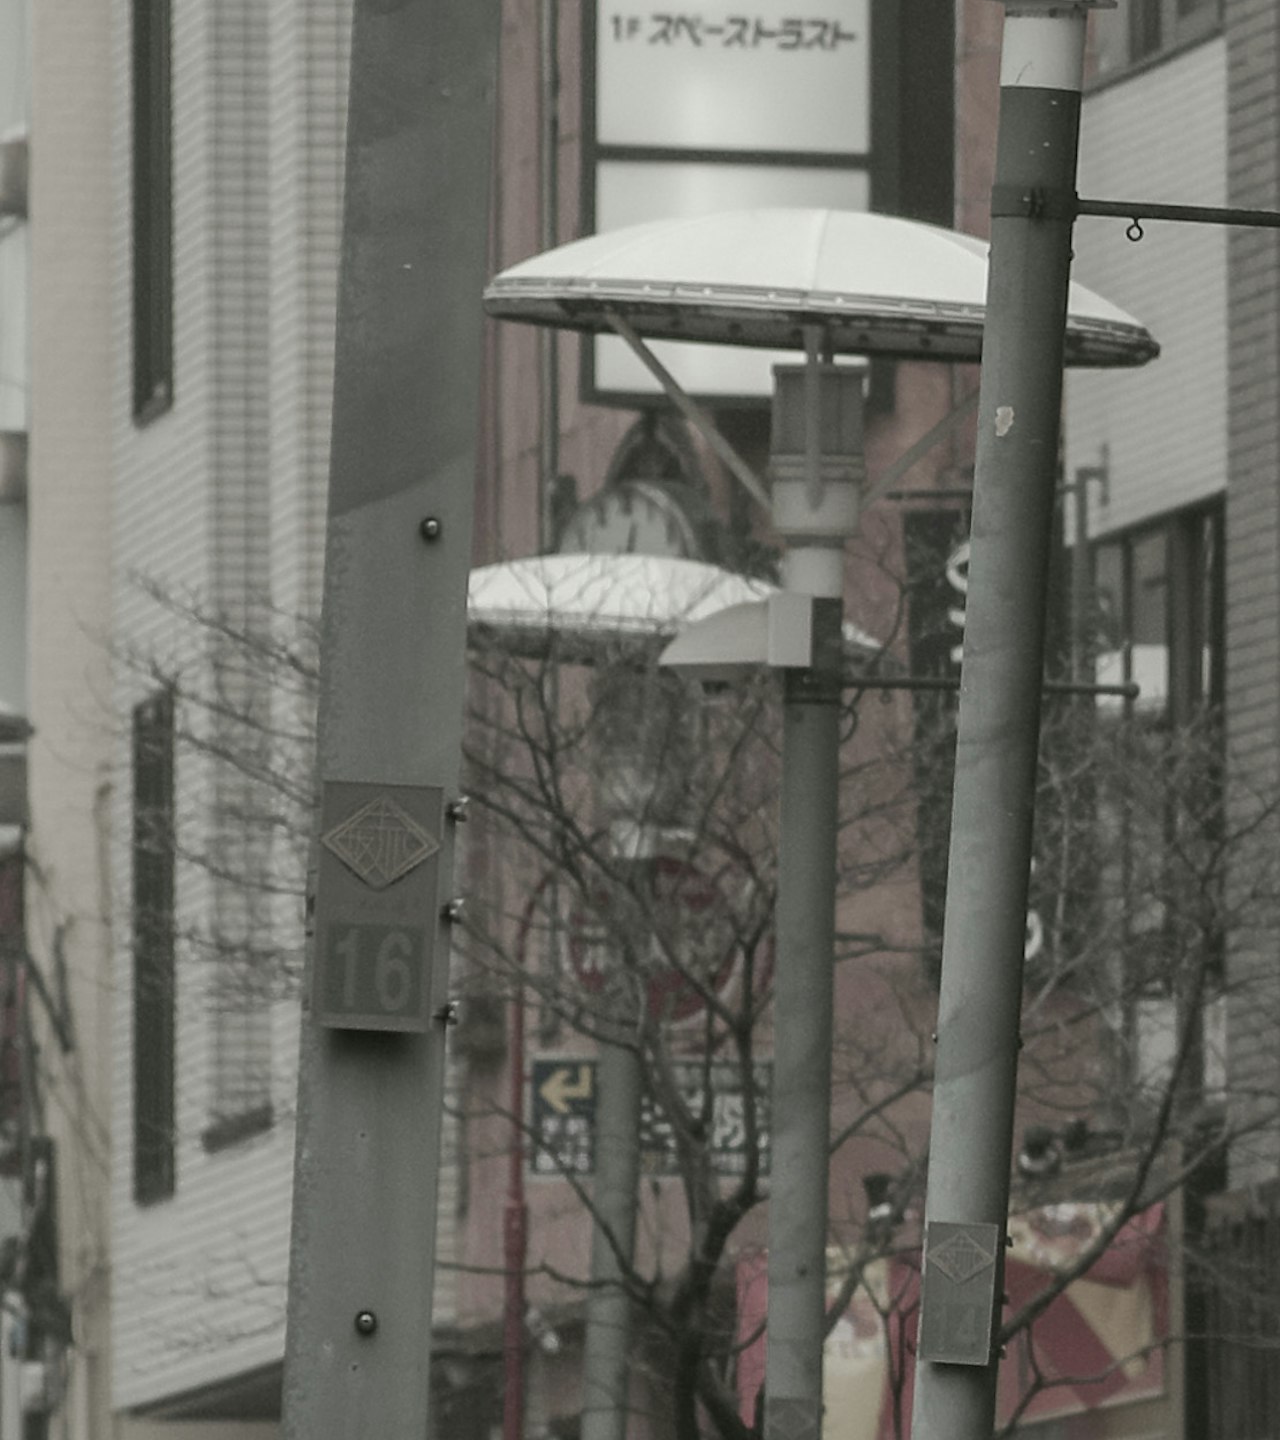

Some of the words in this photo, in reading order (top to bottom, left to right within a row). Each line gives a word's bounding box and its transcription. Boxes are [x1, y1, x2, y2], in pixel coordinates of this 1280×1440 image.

[649, 14, 856, 51] スペーストラスト
[337, 928, 413, 1011] 16
